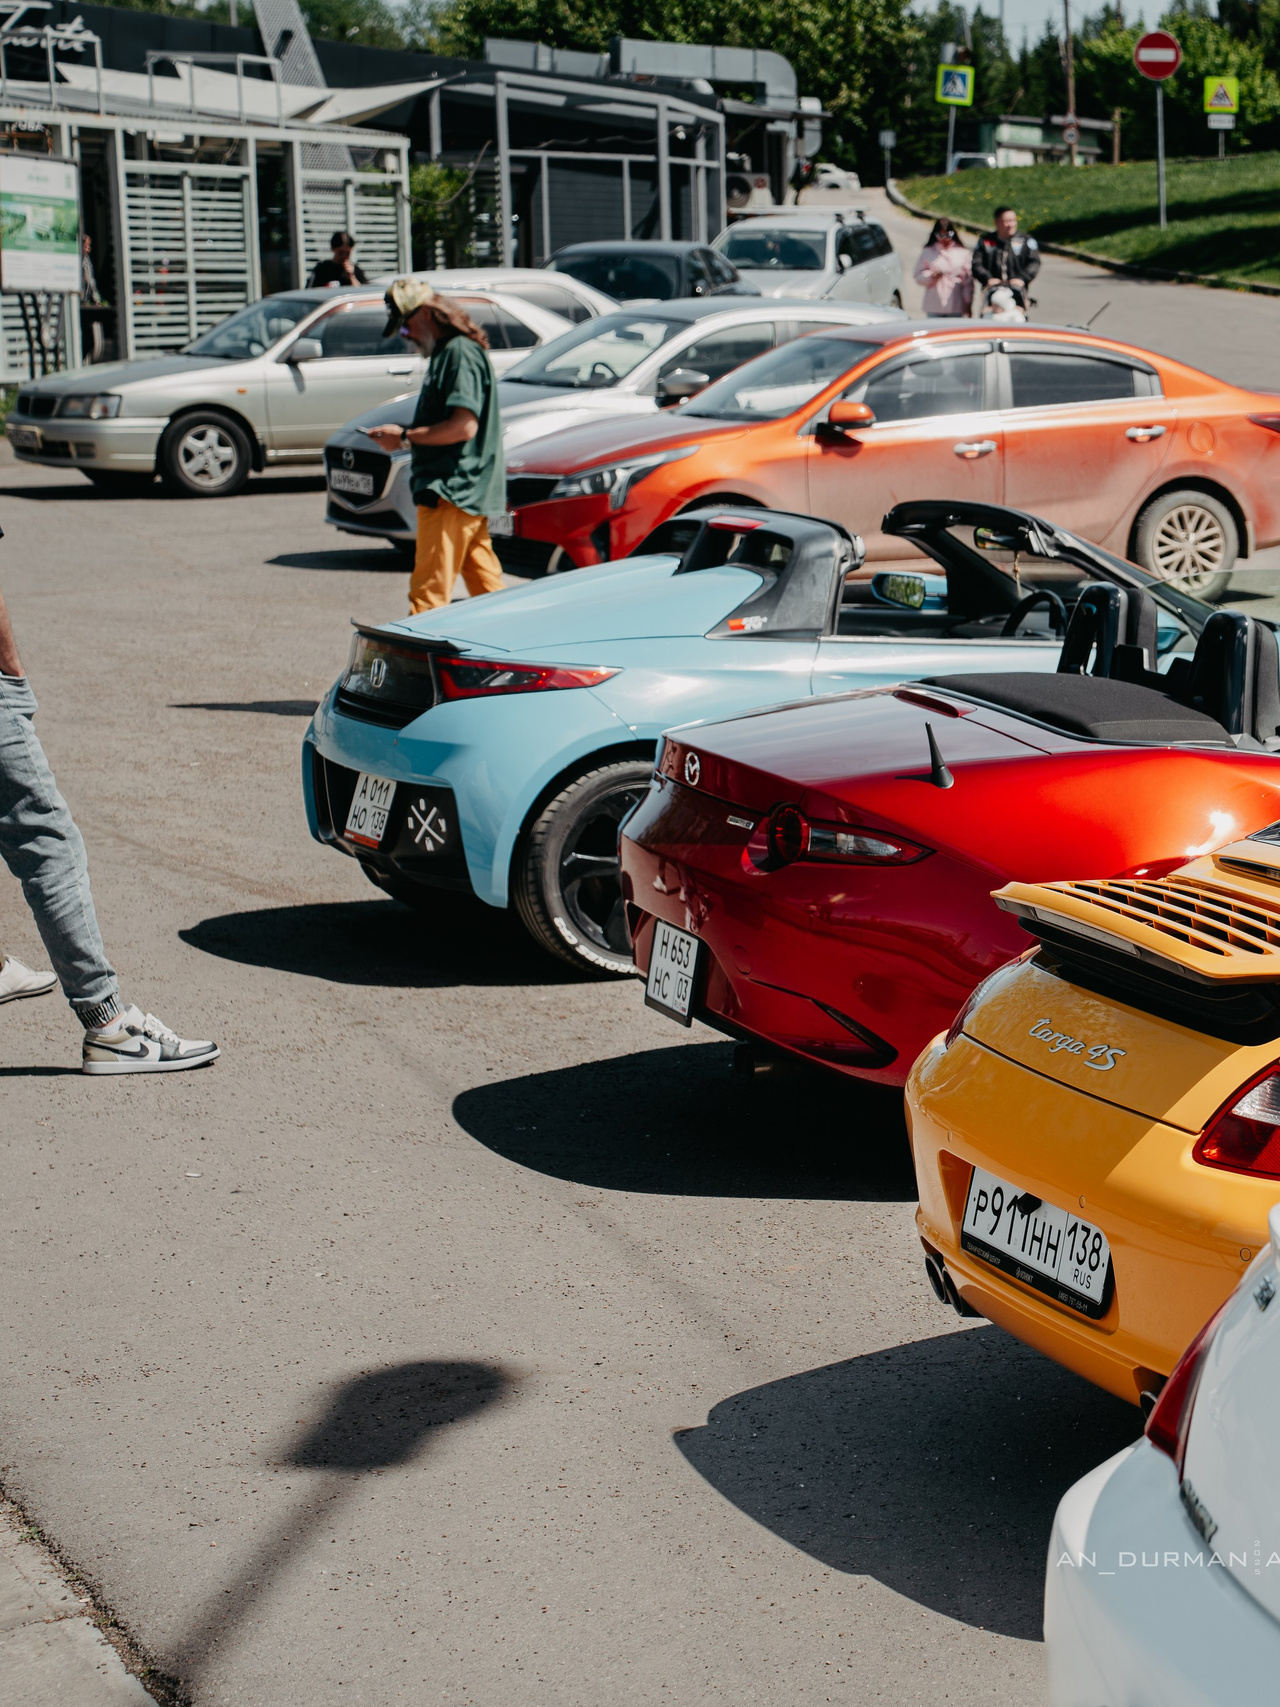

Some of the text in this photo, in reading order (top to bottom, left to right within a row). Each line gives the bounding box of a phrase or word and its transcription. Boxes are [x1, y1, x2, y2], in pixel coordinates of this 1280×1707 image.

[360, 775, 391, 806] A 011
[349, 805, 367, 830] HO
[371, 810, 386, 831] 138
[660, 929, 691, 969] H 653
[653, 966, 689, 1002] HC 03
[1083, 1044, 1127, 1071] 4S
[1067, 1221, 1103, 1272] 138
[1073, 1268, 1092, 1290] RUS
